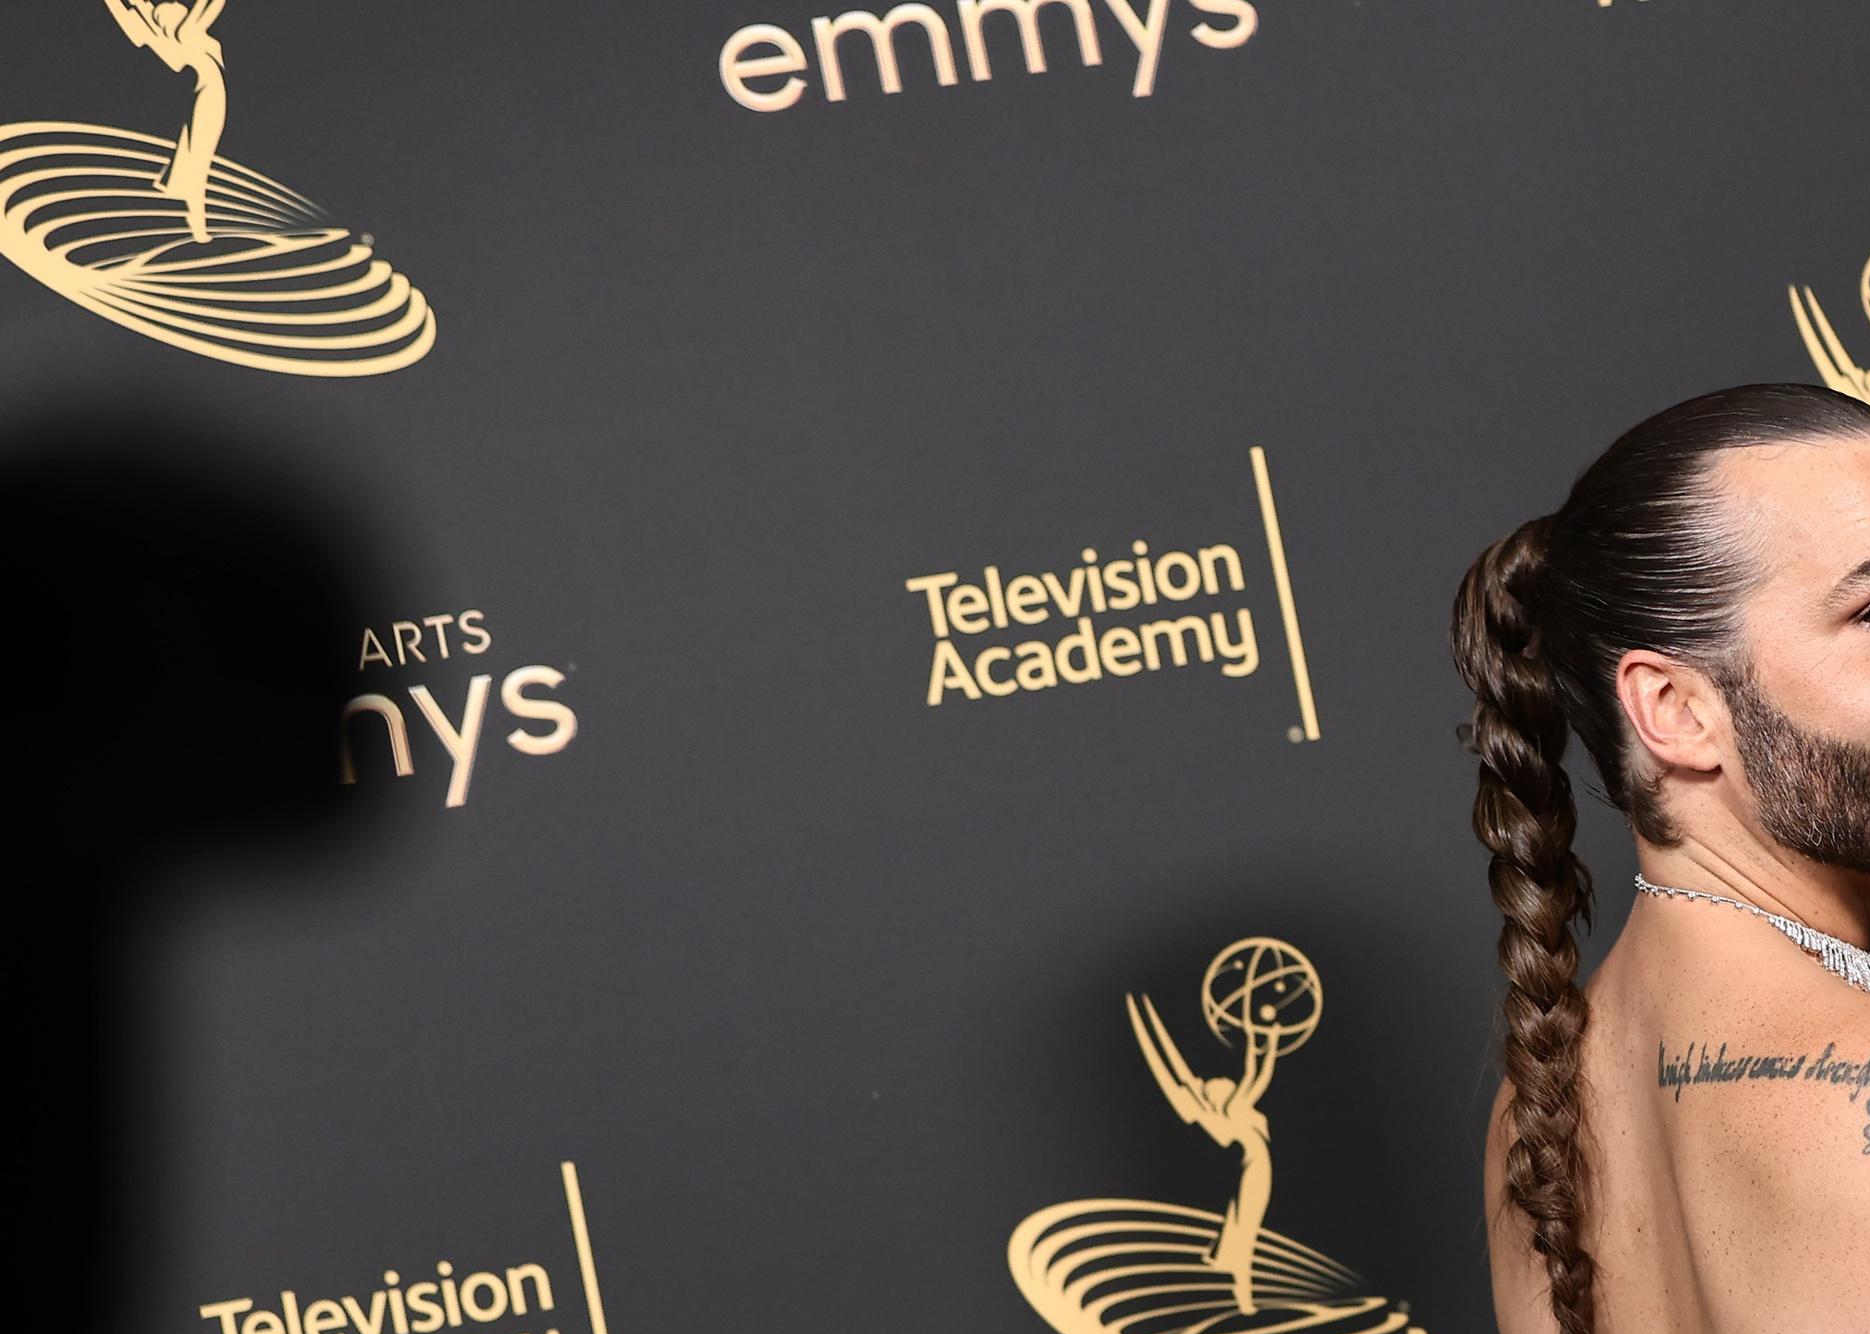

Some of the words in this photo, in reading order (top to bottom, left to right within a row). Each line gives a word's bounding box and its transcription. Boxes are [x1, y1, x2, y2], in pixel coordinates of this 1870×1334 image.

[906, 540, 1245, 638] Television
[358, 610, 491, 671] ARTS
[927, 608, 1259, 706] Academy
